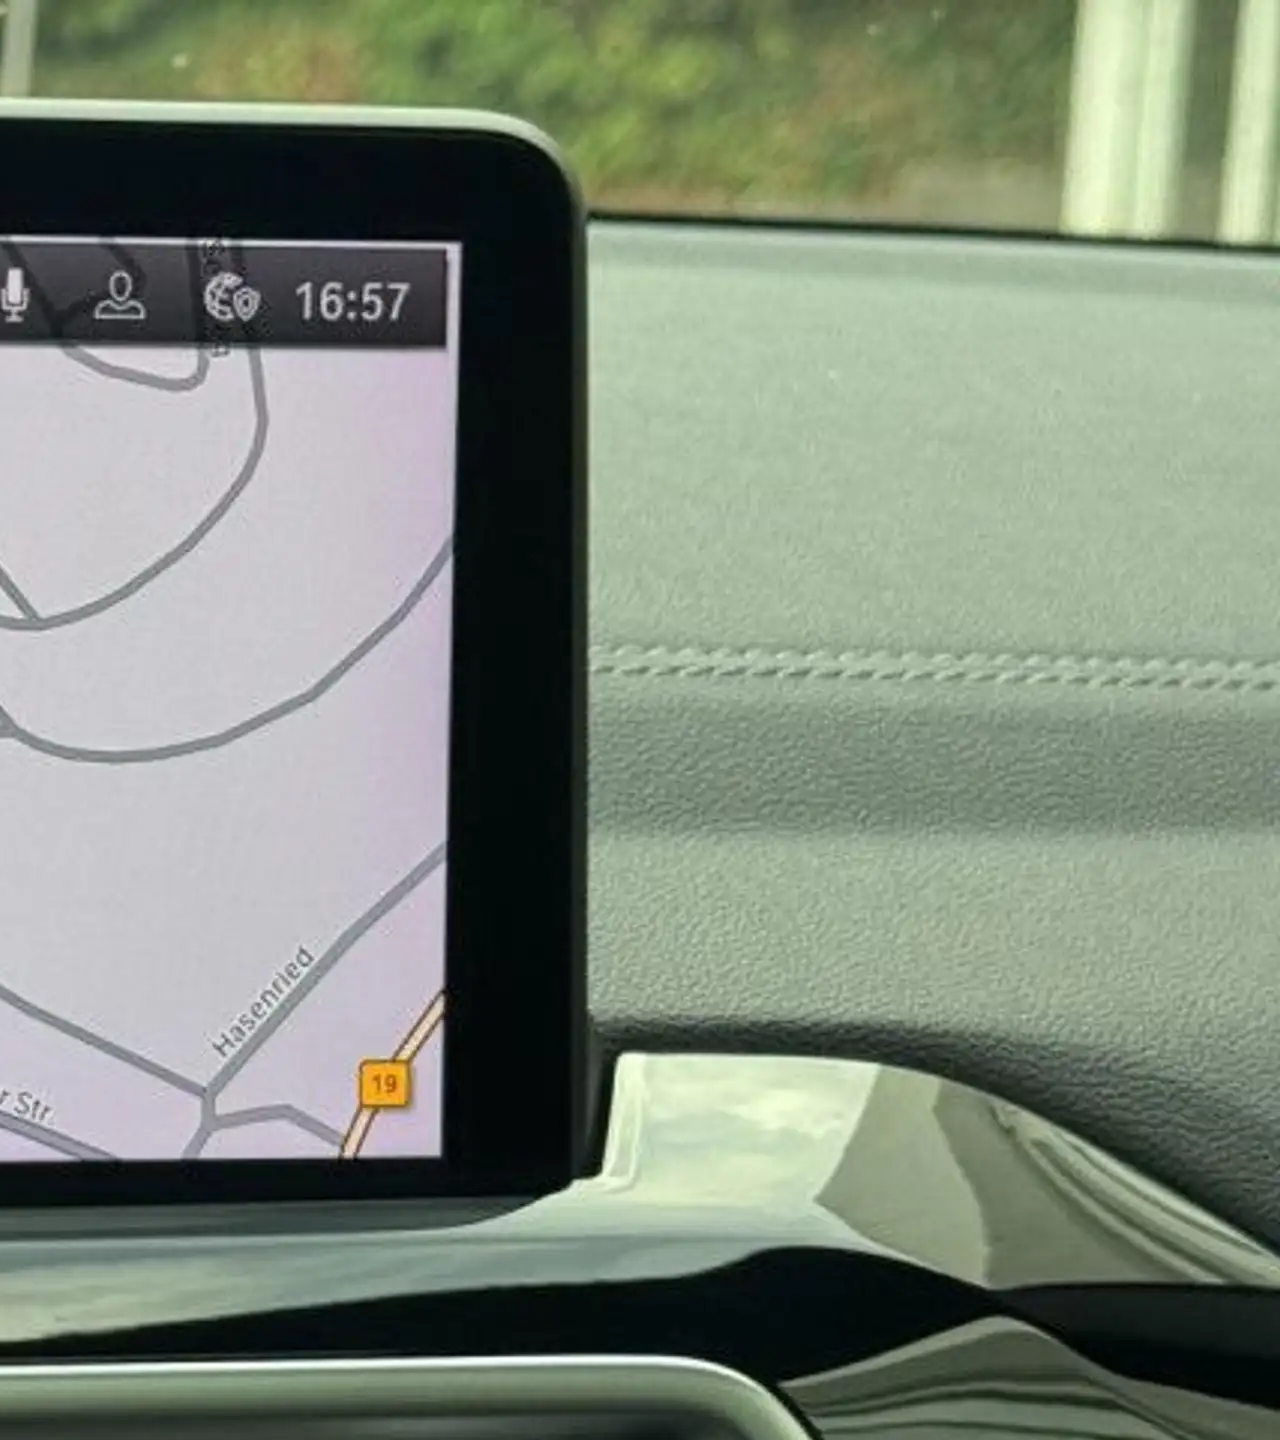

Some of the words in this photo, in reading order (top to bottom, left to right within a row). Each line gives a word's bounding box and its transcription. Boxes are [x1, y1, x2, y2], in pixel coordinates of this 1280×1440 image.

[295, 282, 412, 321] 16:57
[213, 945, 315, 1059] Hasenried
[371, 1075, 398, 1094] 19
[13, 1085, 53, 1123] Str.
